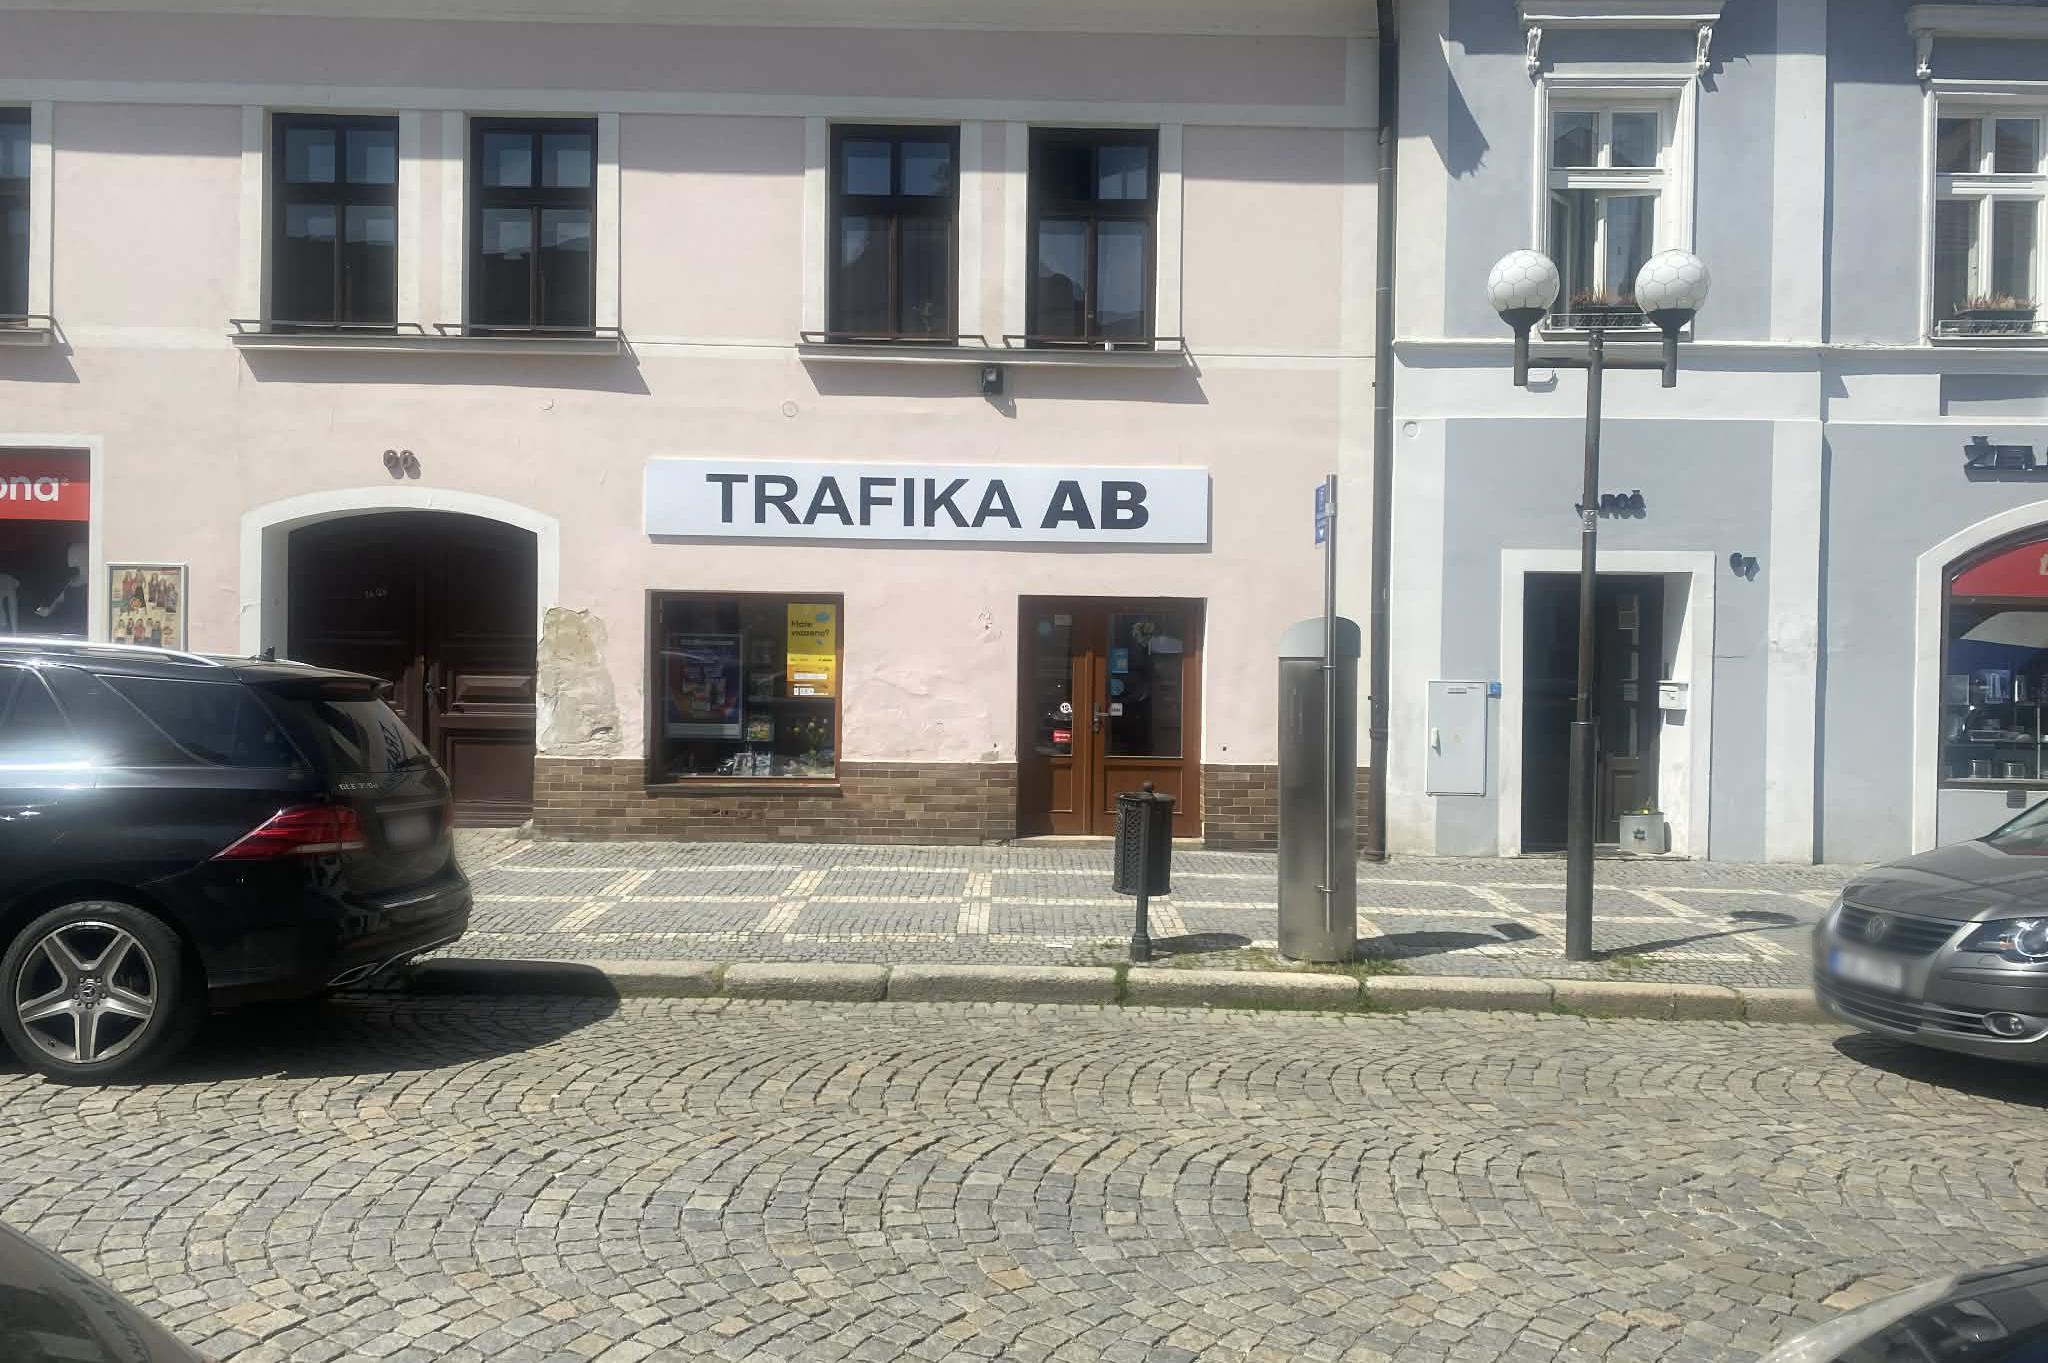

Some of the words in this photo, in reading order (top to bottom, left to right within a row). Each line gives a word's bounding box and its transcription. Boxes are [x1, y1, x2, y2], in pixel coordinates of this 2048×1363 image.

[1964, 436, 2048, 479] ŽEL
[706, 473, 1022, 529] TRAFIKA
[1040, 480, 1149, 530] AB
[1575, 489, 1647, 518] ROŠ
